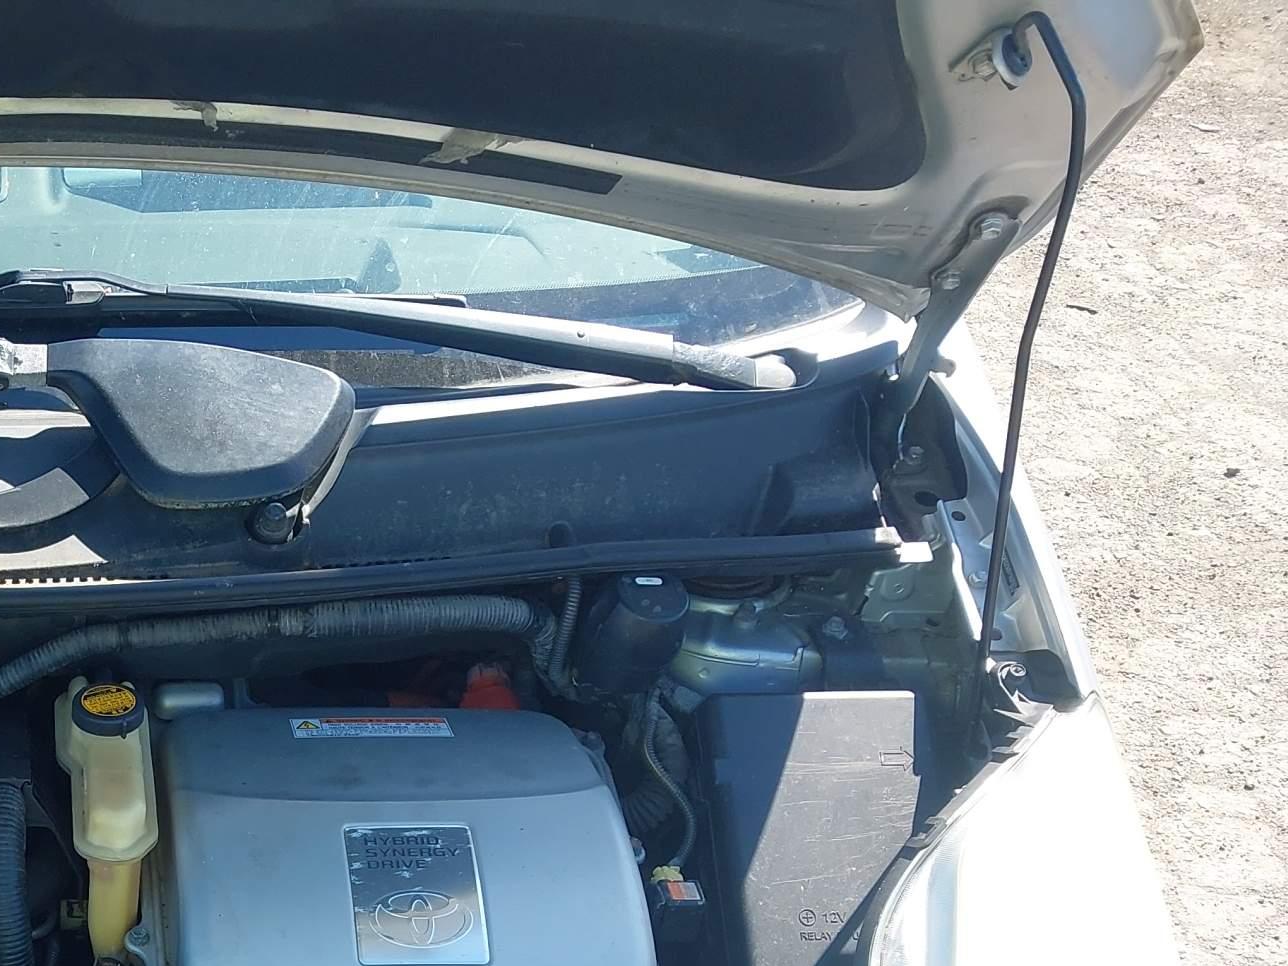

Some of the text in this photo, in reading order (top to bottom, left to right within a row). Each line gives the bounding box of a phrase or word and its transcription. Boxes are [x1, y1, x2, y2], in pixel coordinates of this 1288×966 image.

[363, 836, 439, 846] HYBRID
[365, 847, 459, 858] SYNERGY
[367, 859, 427, 870] DRIVE
[821, 911, 847, 924] 12V
